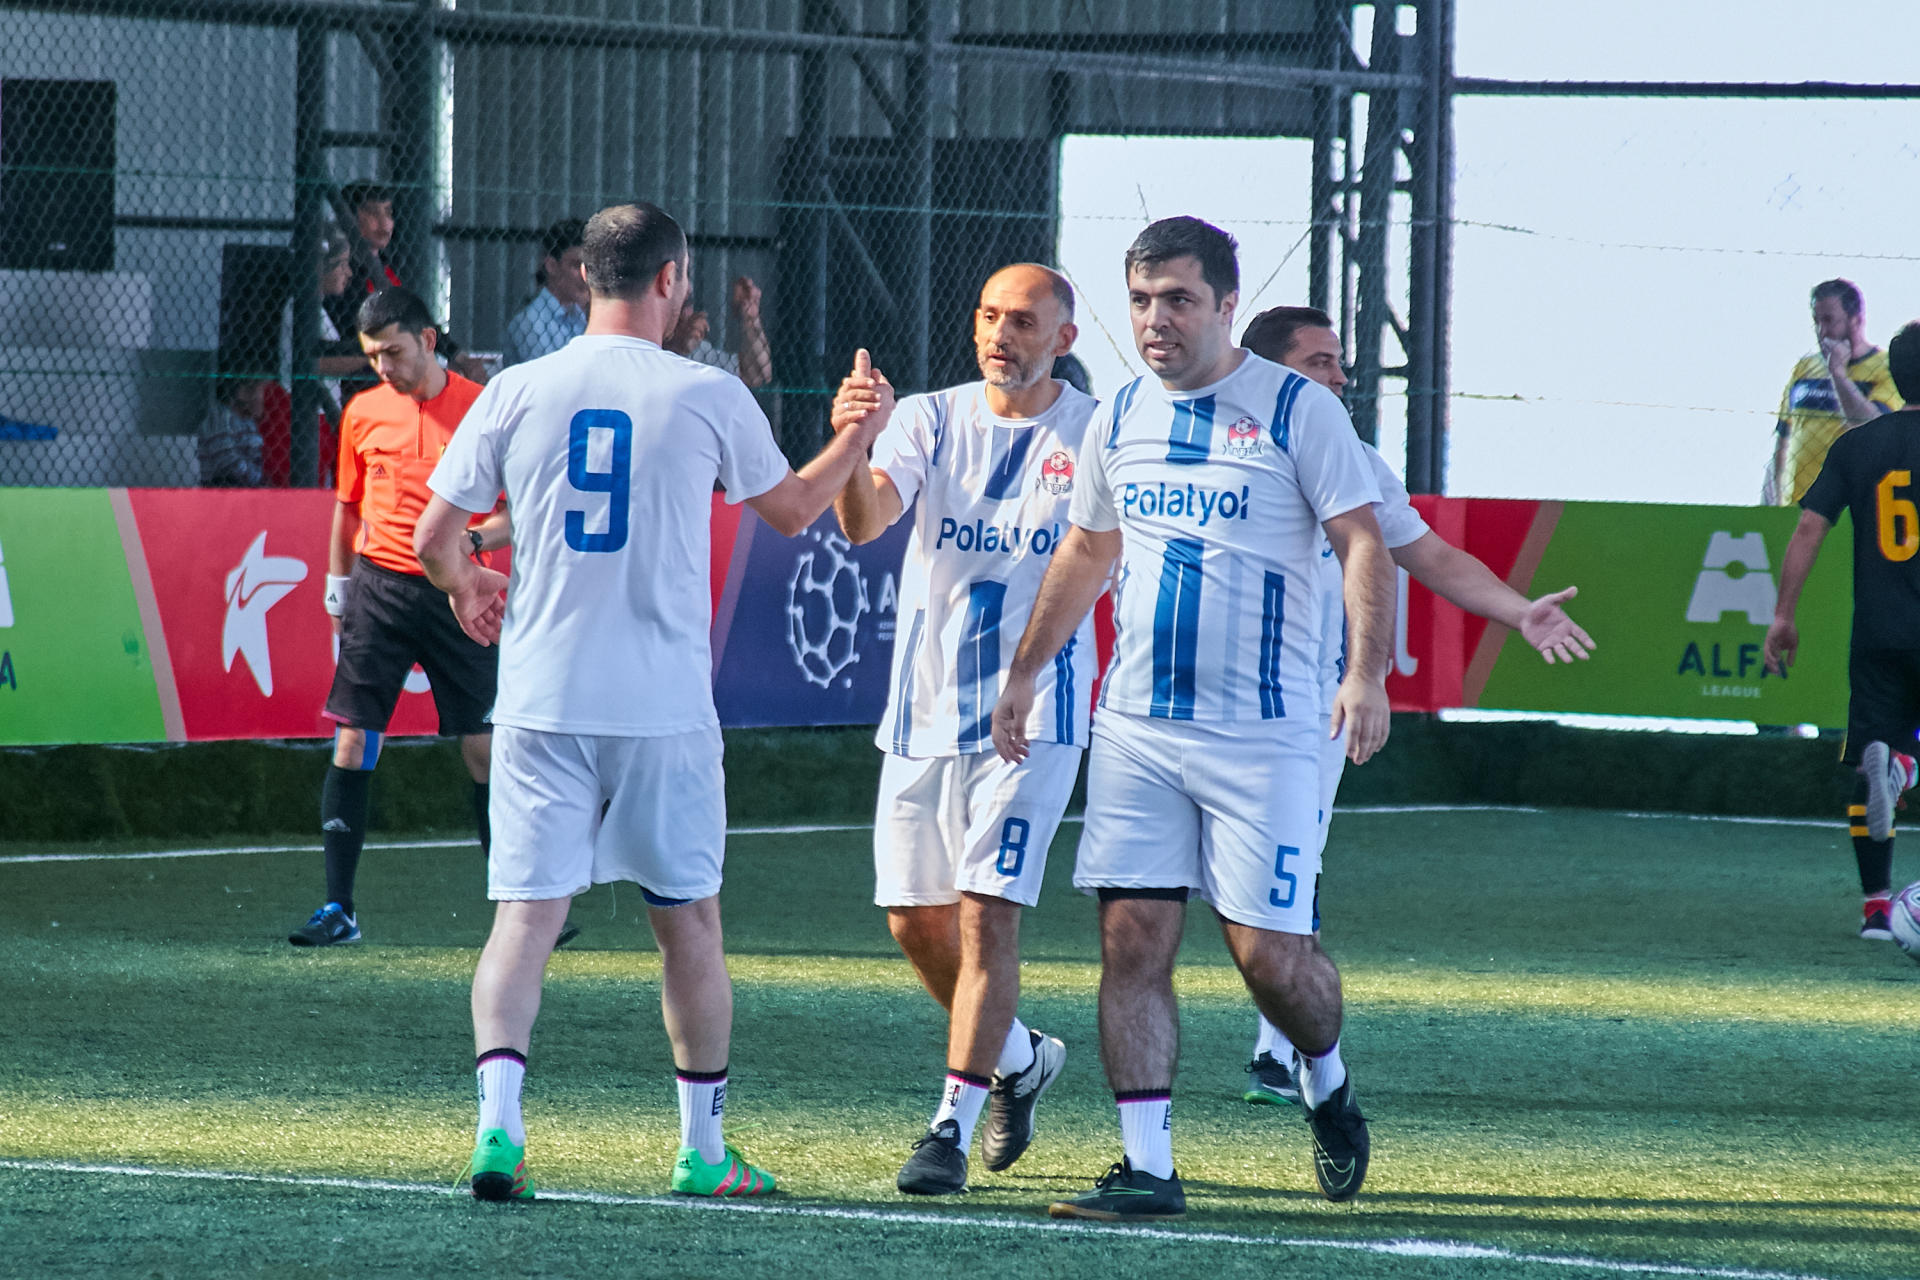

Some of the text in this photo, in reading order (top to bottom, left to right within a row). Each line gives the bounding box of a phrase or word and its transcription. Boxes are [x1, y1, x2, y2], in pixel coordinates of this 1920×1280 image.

[565, 409, 632, 553] 9
[1124, 482, 1249, 527] Polatyol
[1876, 470, 1919, 562] 6
[1702, 685, 1761, 698] LEAGUE
[996, 817, 1030, 877] 8
[1269, 845, 1300, 909] 5
